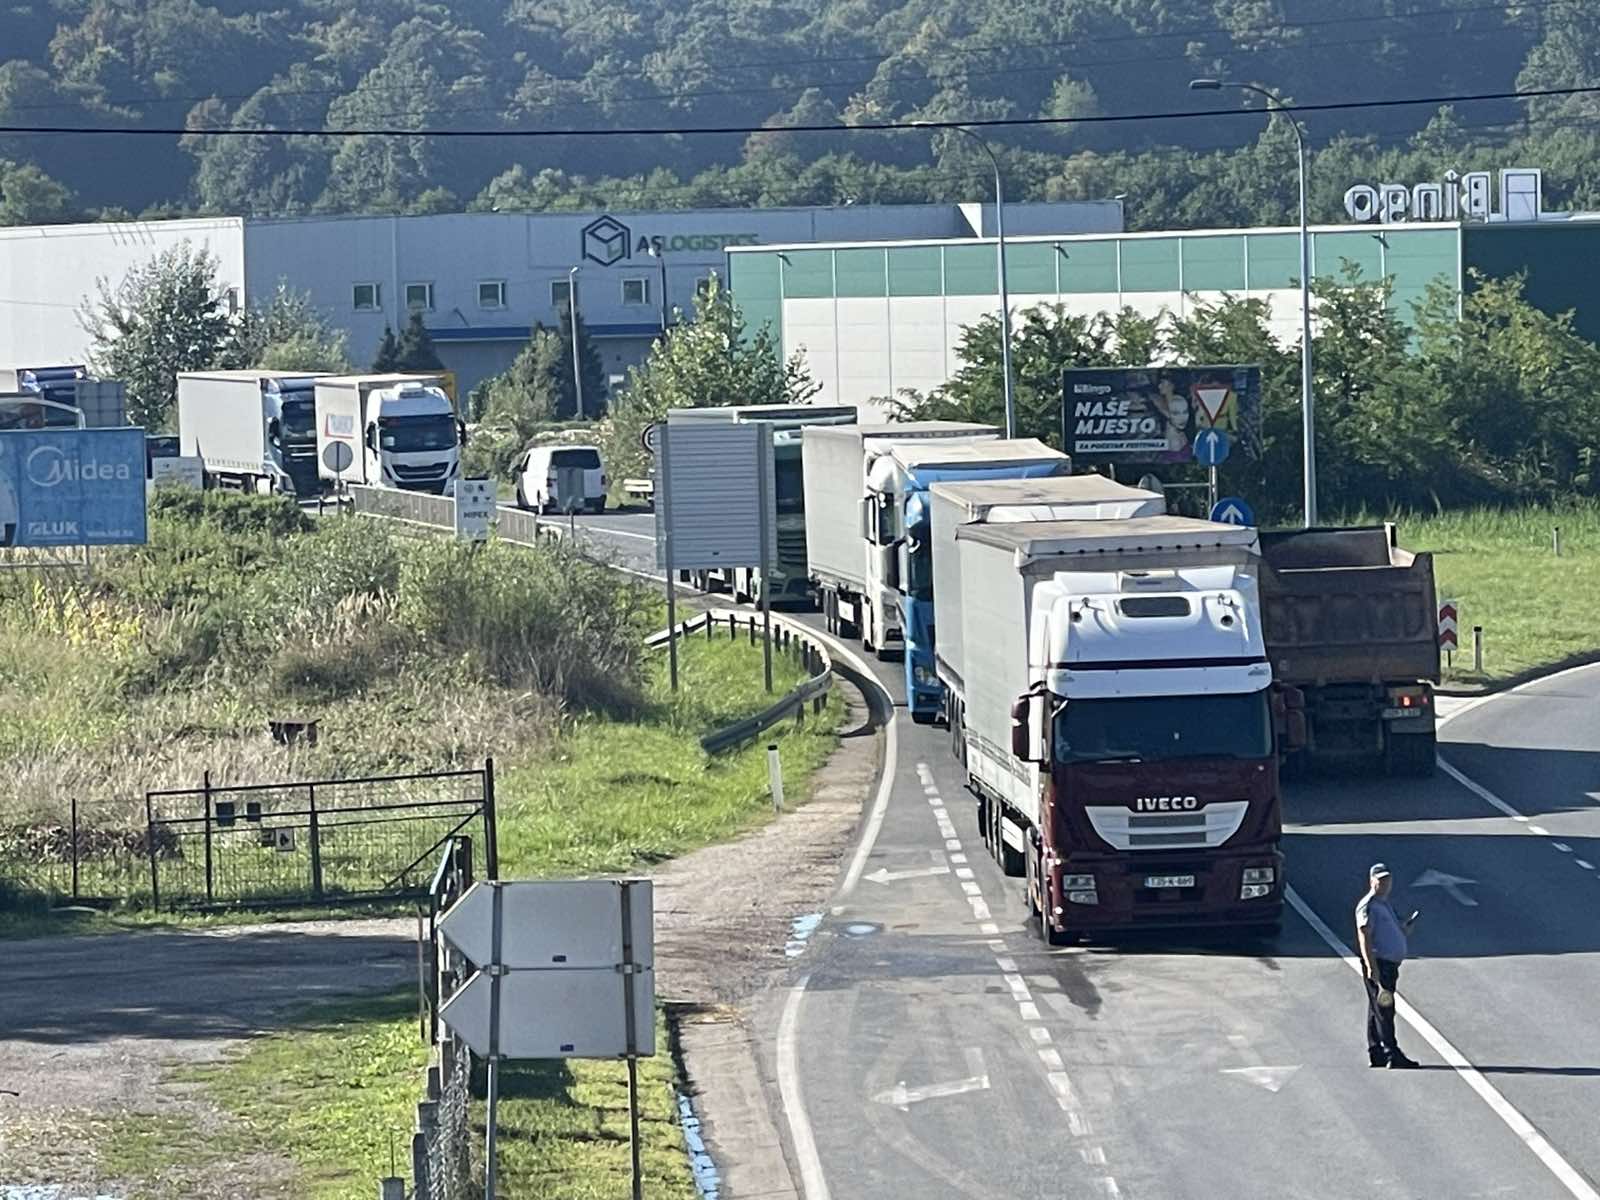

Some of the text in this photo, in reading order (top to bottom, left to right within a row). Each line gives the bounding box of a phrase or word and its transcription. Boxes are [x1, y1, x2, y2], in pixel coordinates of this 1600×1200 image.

[1075, 396, 1130, 417] NAŠE
[1075, 418, 1156, 435] MJESTO
[43, 454, 129, 482] Midea
[1137, 796, 1197, 811] IVECO
